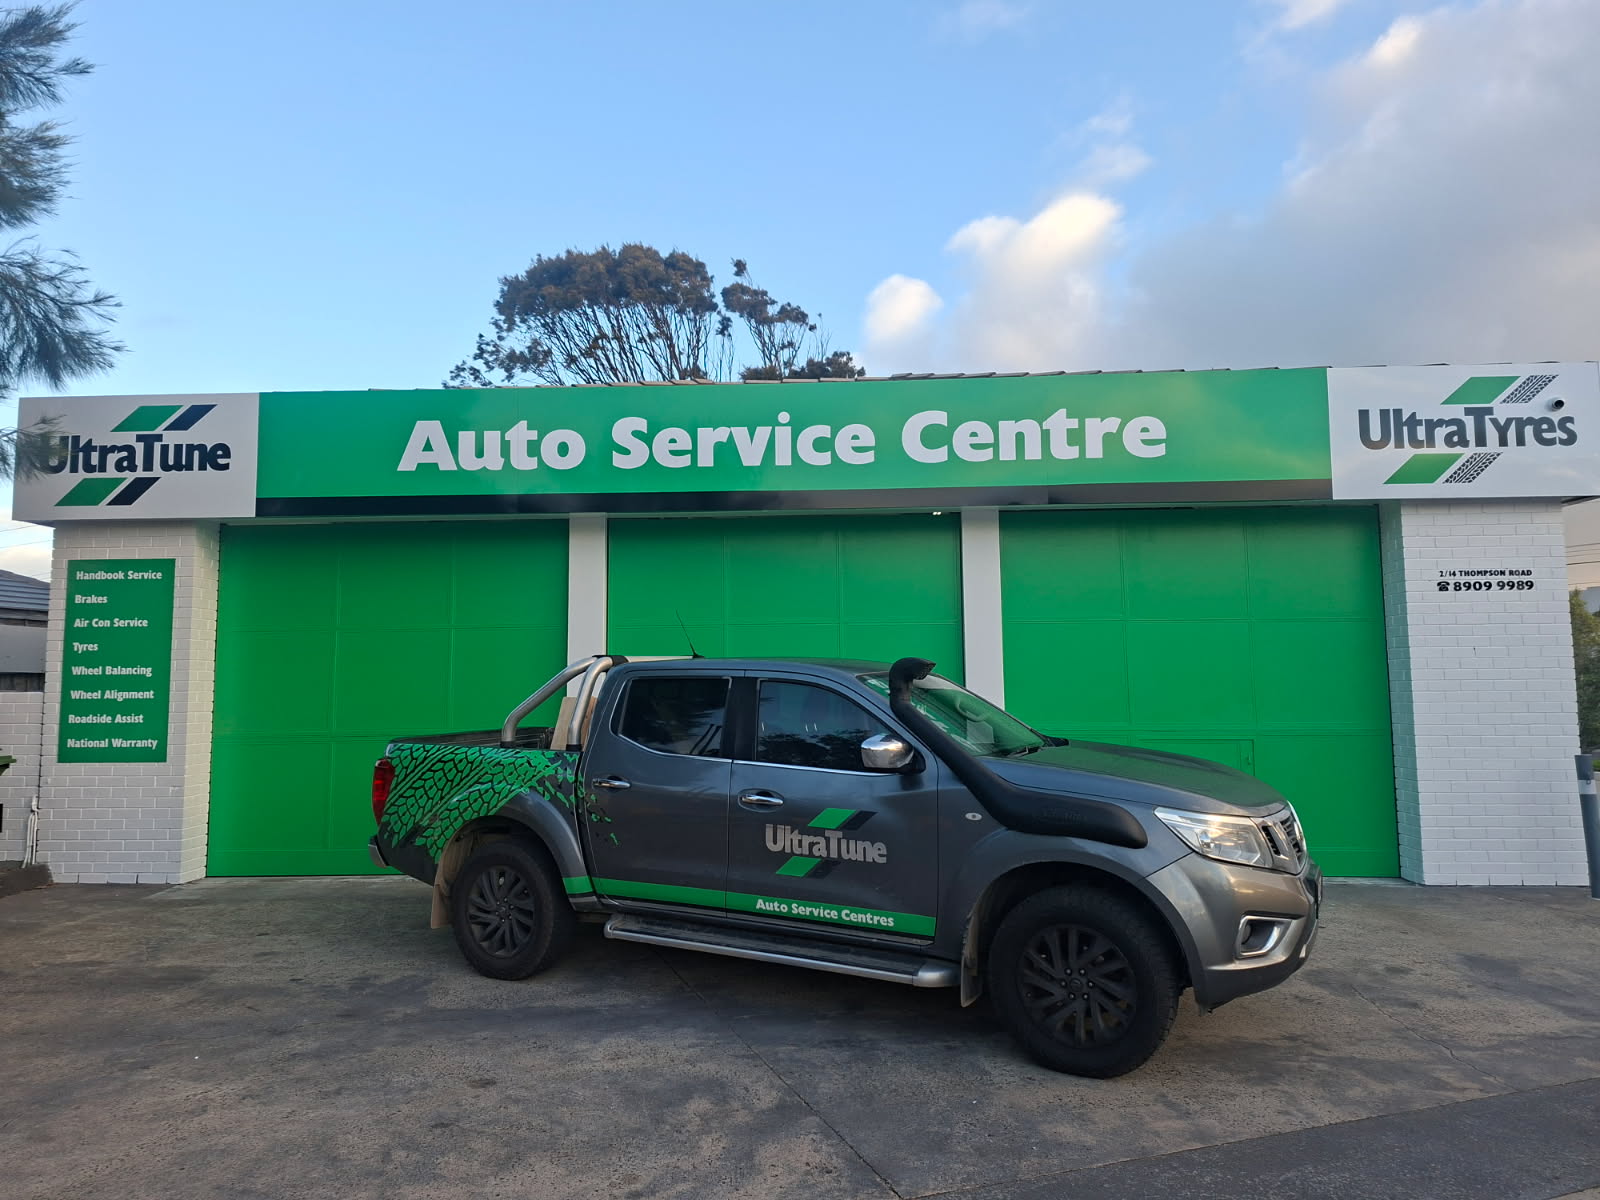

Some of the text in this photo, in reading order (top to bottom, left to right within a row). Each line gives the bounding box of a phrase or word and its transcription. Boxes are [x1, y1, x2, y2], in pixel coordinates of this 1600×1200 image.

[1358, 406, 1578, 450] UltraTyres
[397, 408, 1167, 471] Auto Service Centre
[76, 570, 162, 580] Handbook Service
[1458, 569, 1506, 577] THOMPSON
[1508, 569, 1533, 577] ROAD
[1453, 580, 1534, 591] 8909 9989
[75, 595, 108, 604] Brakes
[73, 617, 148, 627] Air Con Service
[72, 642, 98, 653] Tyres
[71, 666, 152, 677] Wheel Balancing
[70, 690, 154, 701] Wheel Alignment
[68, 714, 144, 724] Roadside Assist
[67, 738, 158, 750] National Warranty
[765, 823, 888, 864] UltraTune
[755, 899, 894, 927] Auto Service Centres
